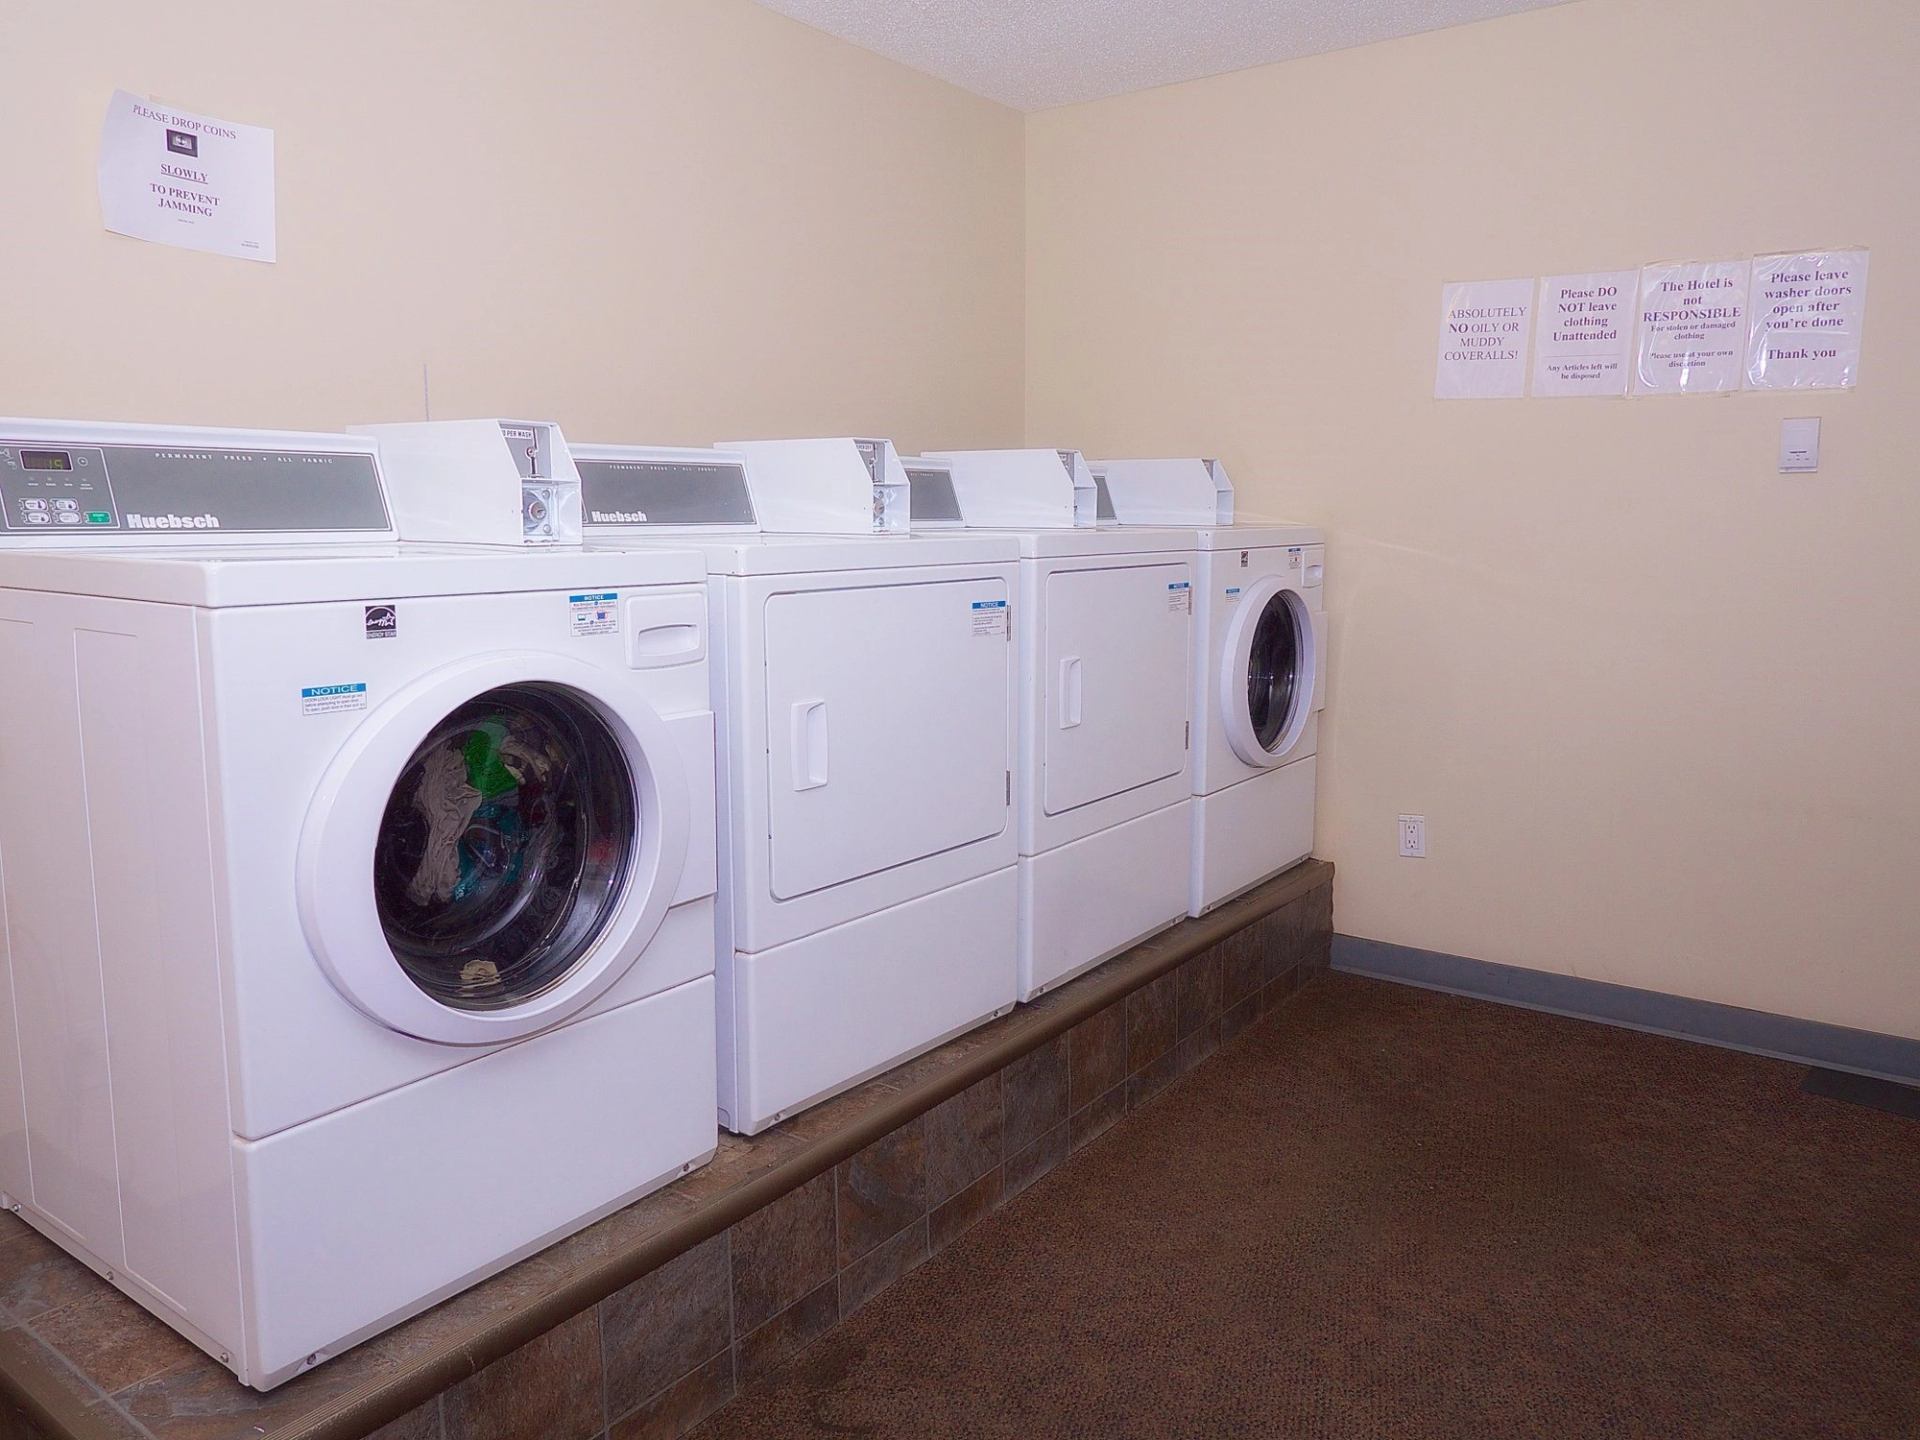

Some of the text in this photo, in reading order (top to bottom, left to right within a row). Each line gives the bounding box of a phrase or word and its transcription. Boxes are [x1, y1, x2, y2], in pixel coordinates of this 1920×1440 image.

[132, 104, 237, 140] PLEASE DROP COINS
[160, 163, 208, 182] SLOWLY
[150, 183, 220, 206] TO PREVENT
[158, 198, 213, 217] JAMMING
[1770, 270, 1849, 284] Please leave
[1661, 277, 1733, 292] The Hotel is
[1560, 286, 1617, 300] Please DO
[1765, 286, 1852, 299] washer doors
[1558, 301, 1617, 313] NOT leave
[1683, 296, 1702, 306] not
[1448, 306, 1527, 319] ABSOLUTELY
[1643, 307, 1742, 322] RESPONSIBLE
[1772, 302, 1840, 316] open after
[1449, 322, 1519, 334] NO OILY OR
[1563, 315, 1608, 328] clothing
[1650, 324, 1664, 332] For
[1666, 323, 1689, 331] stolen
[1700, 321, 1736, 331] damaged
[1766, 316, 1844, 331] you're done
[1460, 337, 1505, 347] MUDDY
[1552, 330, 1617, 342] Unattended
[1674, 332, 1705, 341] clothing
[1444, 350, 1519, 361] COVERALLS!
[1768, 348, 1836, 361] Thank you
[1546, 364, 1560, 372] Any
[1563, 363, 1589, 371] Articles
[1604, 362, 1617, 370] will
[1561, 372, 1601, 381] be disposed
[155, 452, 213, 460] PERMANENT
[126, 513, 220, 529] Huebsch
[591, 510, 648, 522] Huebsch
[311, 685, 358, 696] NOTICE
